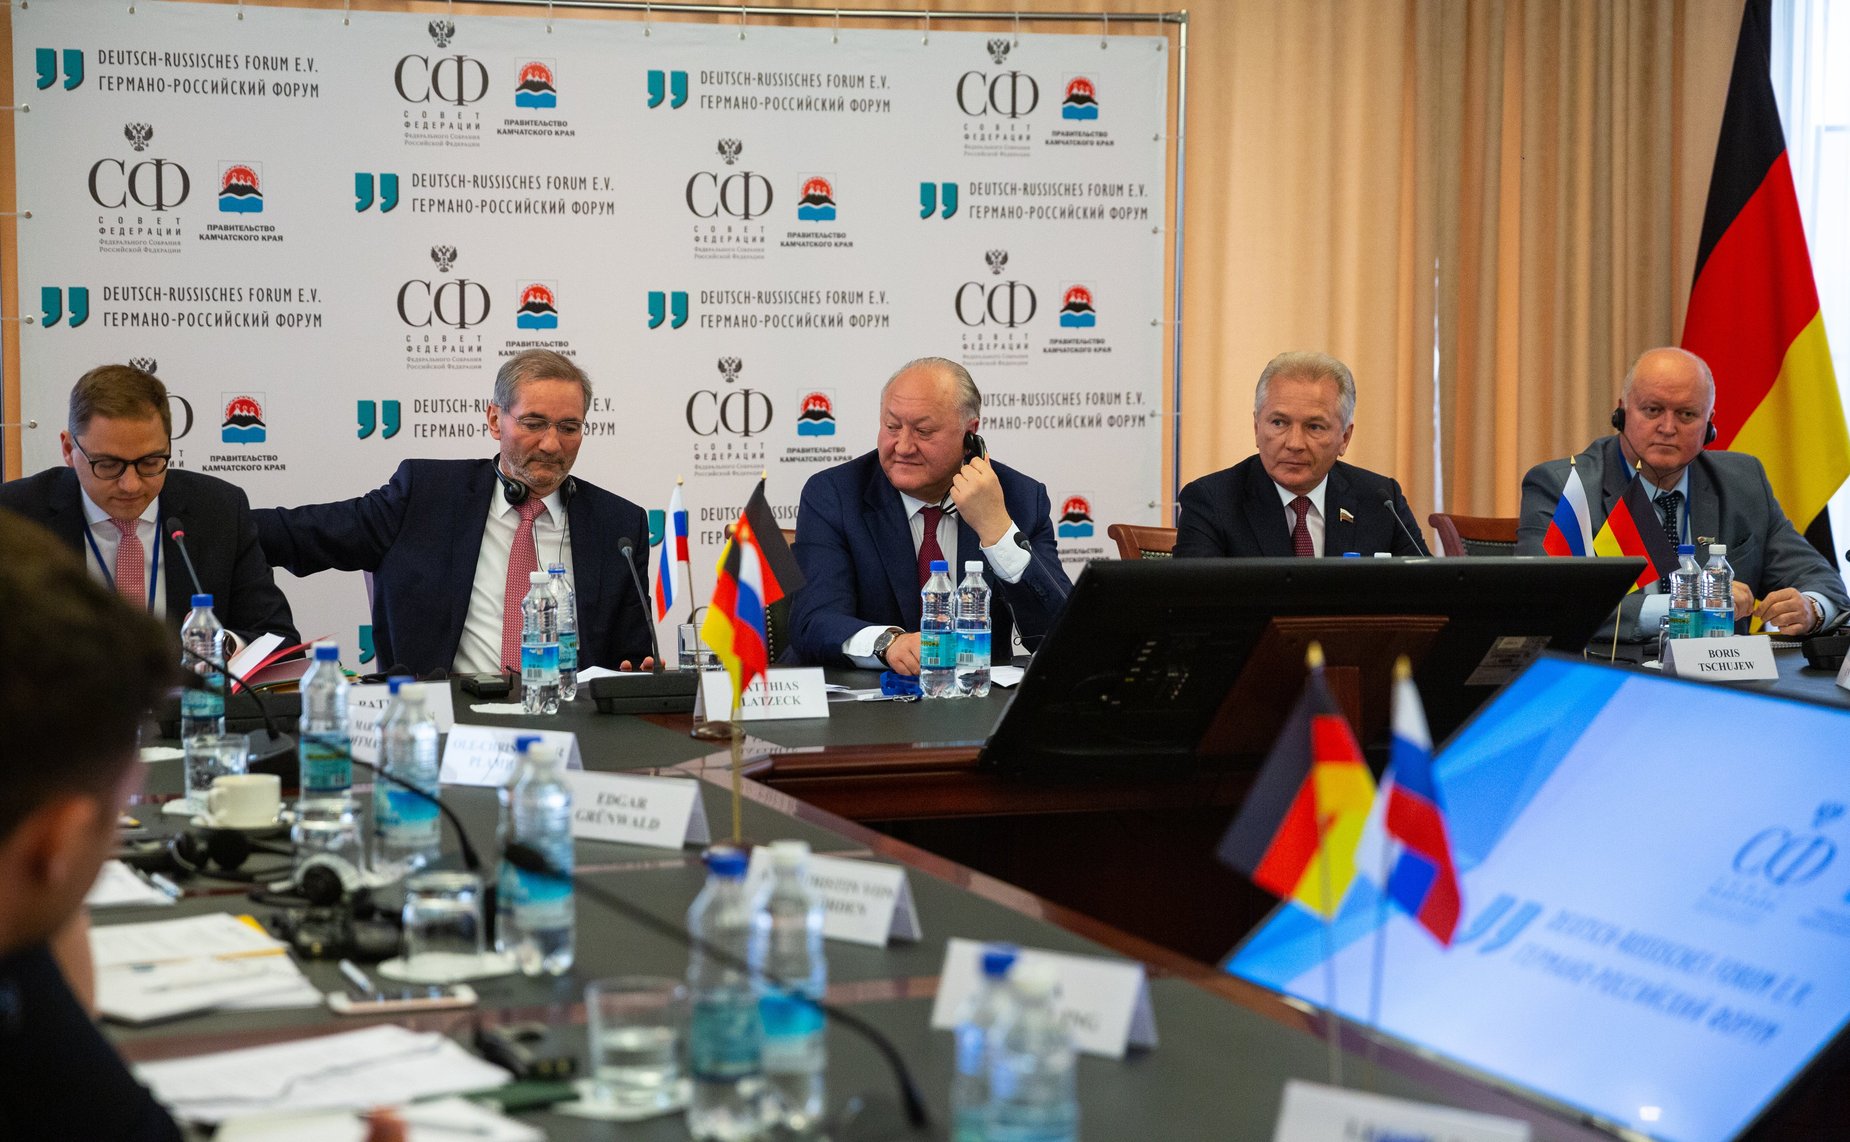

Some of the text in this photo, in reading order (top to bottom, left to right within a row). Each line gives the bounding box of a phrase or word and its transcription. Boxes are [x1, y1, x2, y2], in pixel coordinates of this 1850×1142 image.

[99, 49, 319, 73] DEUTSCH-RUSSISCHES FORUM E.V.
[99, 75, 319, 98] ГЕРМАНО-РОССИЙСКИЙ ФОРУМ
[394, 54, 489, 106] СФ
[701, 70, 890, 90] DEUTSCH-RUSSISCHES FORUM E.V.
[956, 71, 1039, 118] СФ
[701, 95, 890, 113] ГЕРМАНО-РОССИЙСКИЙ ФОРУМ
[504, 119, 568, 127] ПРАВИТЕЛЬСТВО
[497, 128, 575, 137] КАМЧАТСКОГО КРАЯ
[88, 158, 191, 212] СФ
[412, 173, 615, 191] DEUTSCH-RUSSISCHES FORUM E.V.
[970, 182, 1148, 198] DEUTSCH-RUSSISCHES FORUM E.V.
[686, 171, 774, 220] СФ
[412, 198, 615, 215] ГЕРМАНО-РОССИЙСКИЙ ФОРУМ
[970, 205, 1148, 220] ГЕРМАНО-РОССИЙСКИЙ ФОРУМ
[207, 224, 276, 233] ПРАВИТЕЛЬСТВО
[199, 233, 283, 242] КАМЧАТСКОГО КРАЯ
[103, 286, 321, 303] DEUTSCH-RUSSISCHES FORUM E.V.
[701, 290, 889, 305] DEUTSCH-RUSSISCHES FORUM E.V.
[397, 279, 491, 330] СФ
[955, 280, 1037, 328] СФ
[103, 311, 322, 328] ГЕРМАНО-РОССИЙСКИЙ ФОРУМ
[701, 312, 890, 328] ГЕРМАНО-РОССИЙСКИЙ ФОРУМ
[505, 340, 569, 348] ПРАВИТЕЛЬСТВО
[593, 398, 615, 413] E.V.
[983, 391, 1146, 408] UTSCH-RUSSISCHES FORUM E.V.
[686, 388, 773, 437] СФ
[583, 422, 616, 436] ОРУМ
[982, 414, 1146, 430] РМАНО-РОССИЙСКИЙ ФОРУМ
[209, 454, 278, 462] ПРАВИТЕЛЬСТВО
[202, 464, 262, 472] КАМЧАТСКОГО
[1708, 648, 1740, 659] BORIS
[1698, 661, 1755, 672] TSCHUJEW
[744, 681, 800, 692] ATTHIAS
[741, 695, 801, 707] LATZECK
[597, 792, 648, 810] EDGAR
